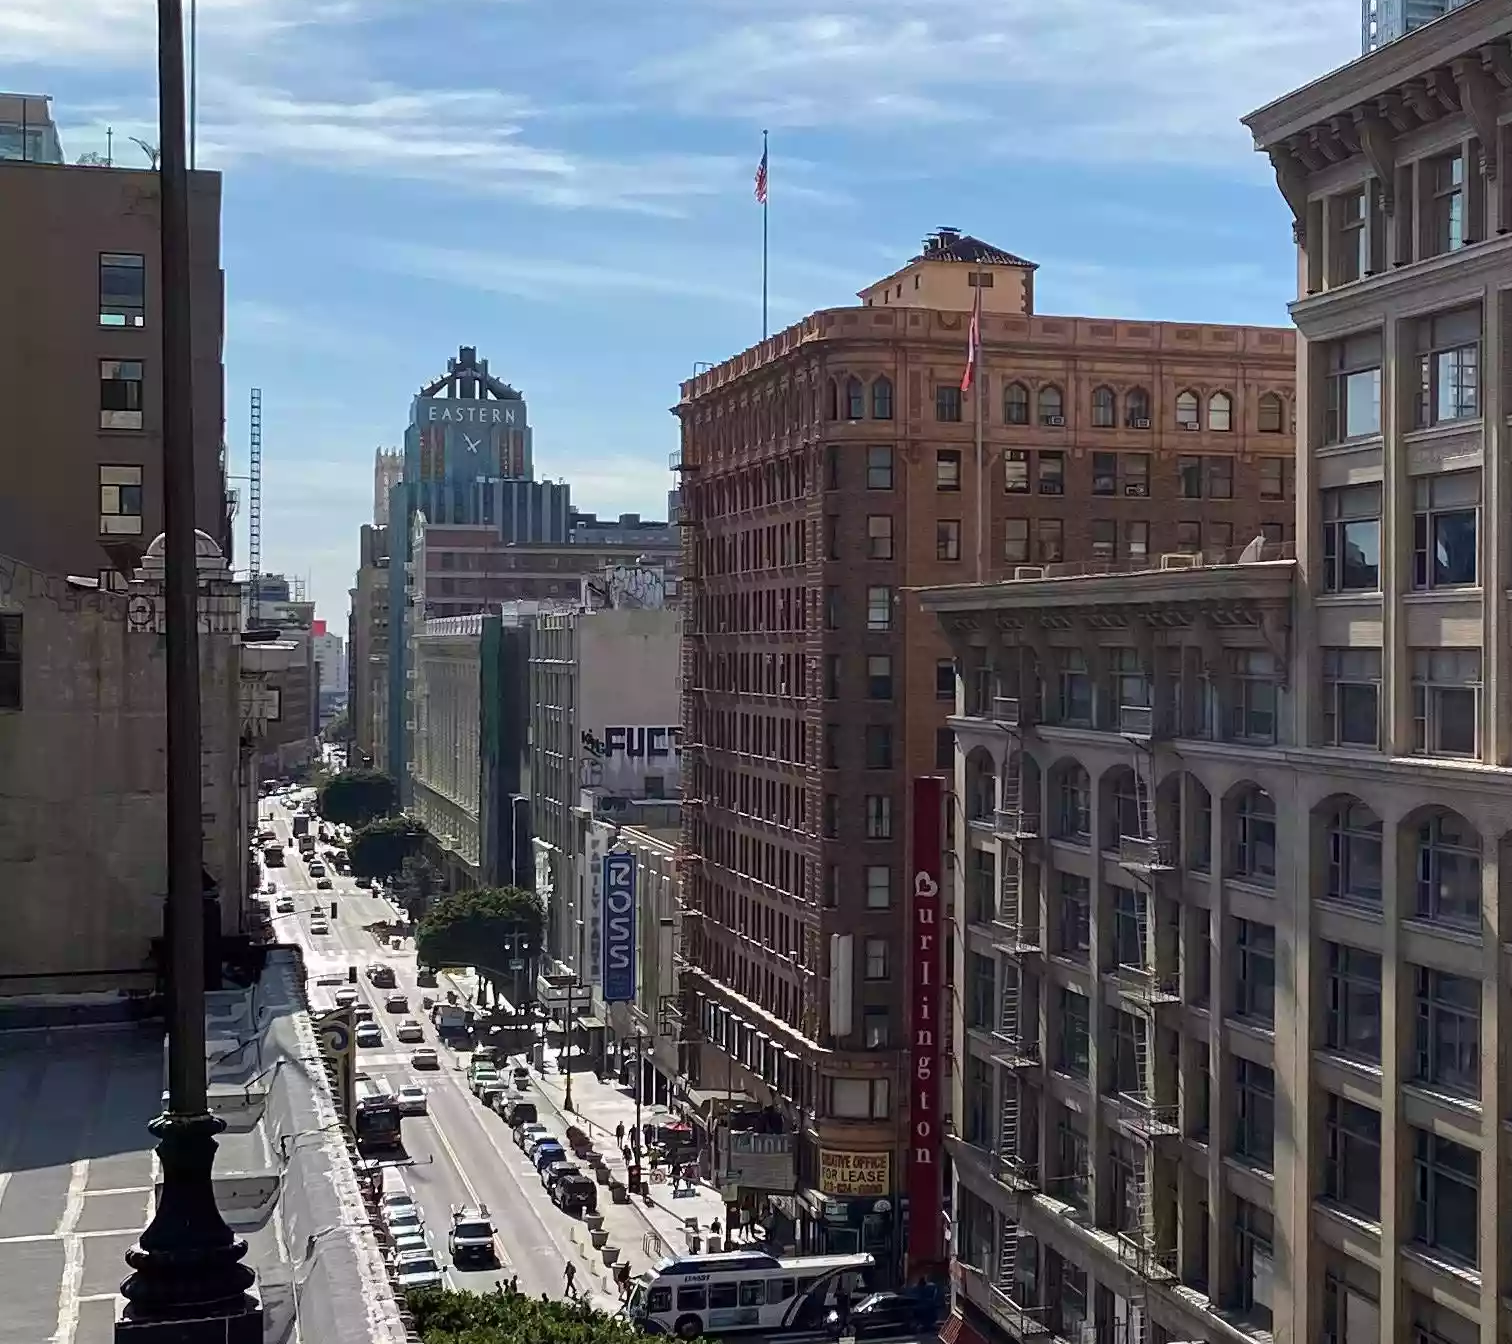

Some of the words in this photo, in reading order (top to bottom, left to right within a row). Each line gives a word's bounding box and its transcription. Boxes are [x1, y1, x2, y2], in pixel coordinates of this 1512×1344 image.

[428, 406, 515, 423] EASTERN
[608, 862, 632, 969] ROSS
[822, 1167, 838, 1180] FOR
[841, 1171, 885, 1182] LEASE
